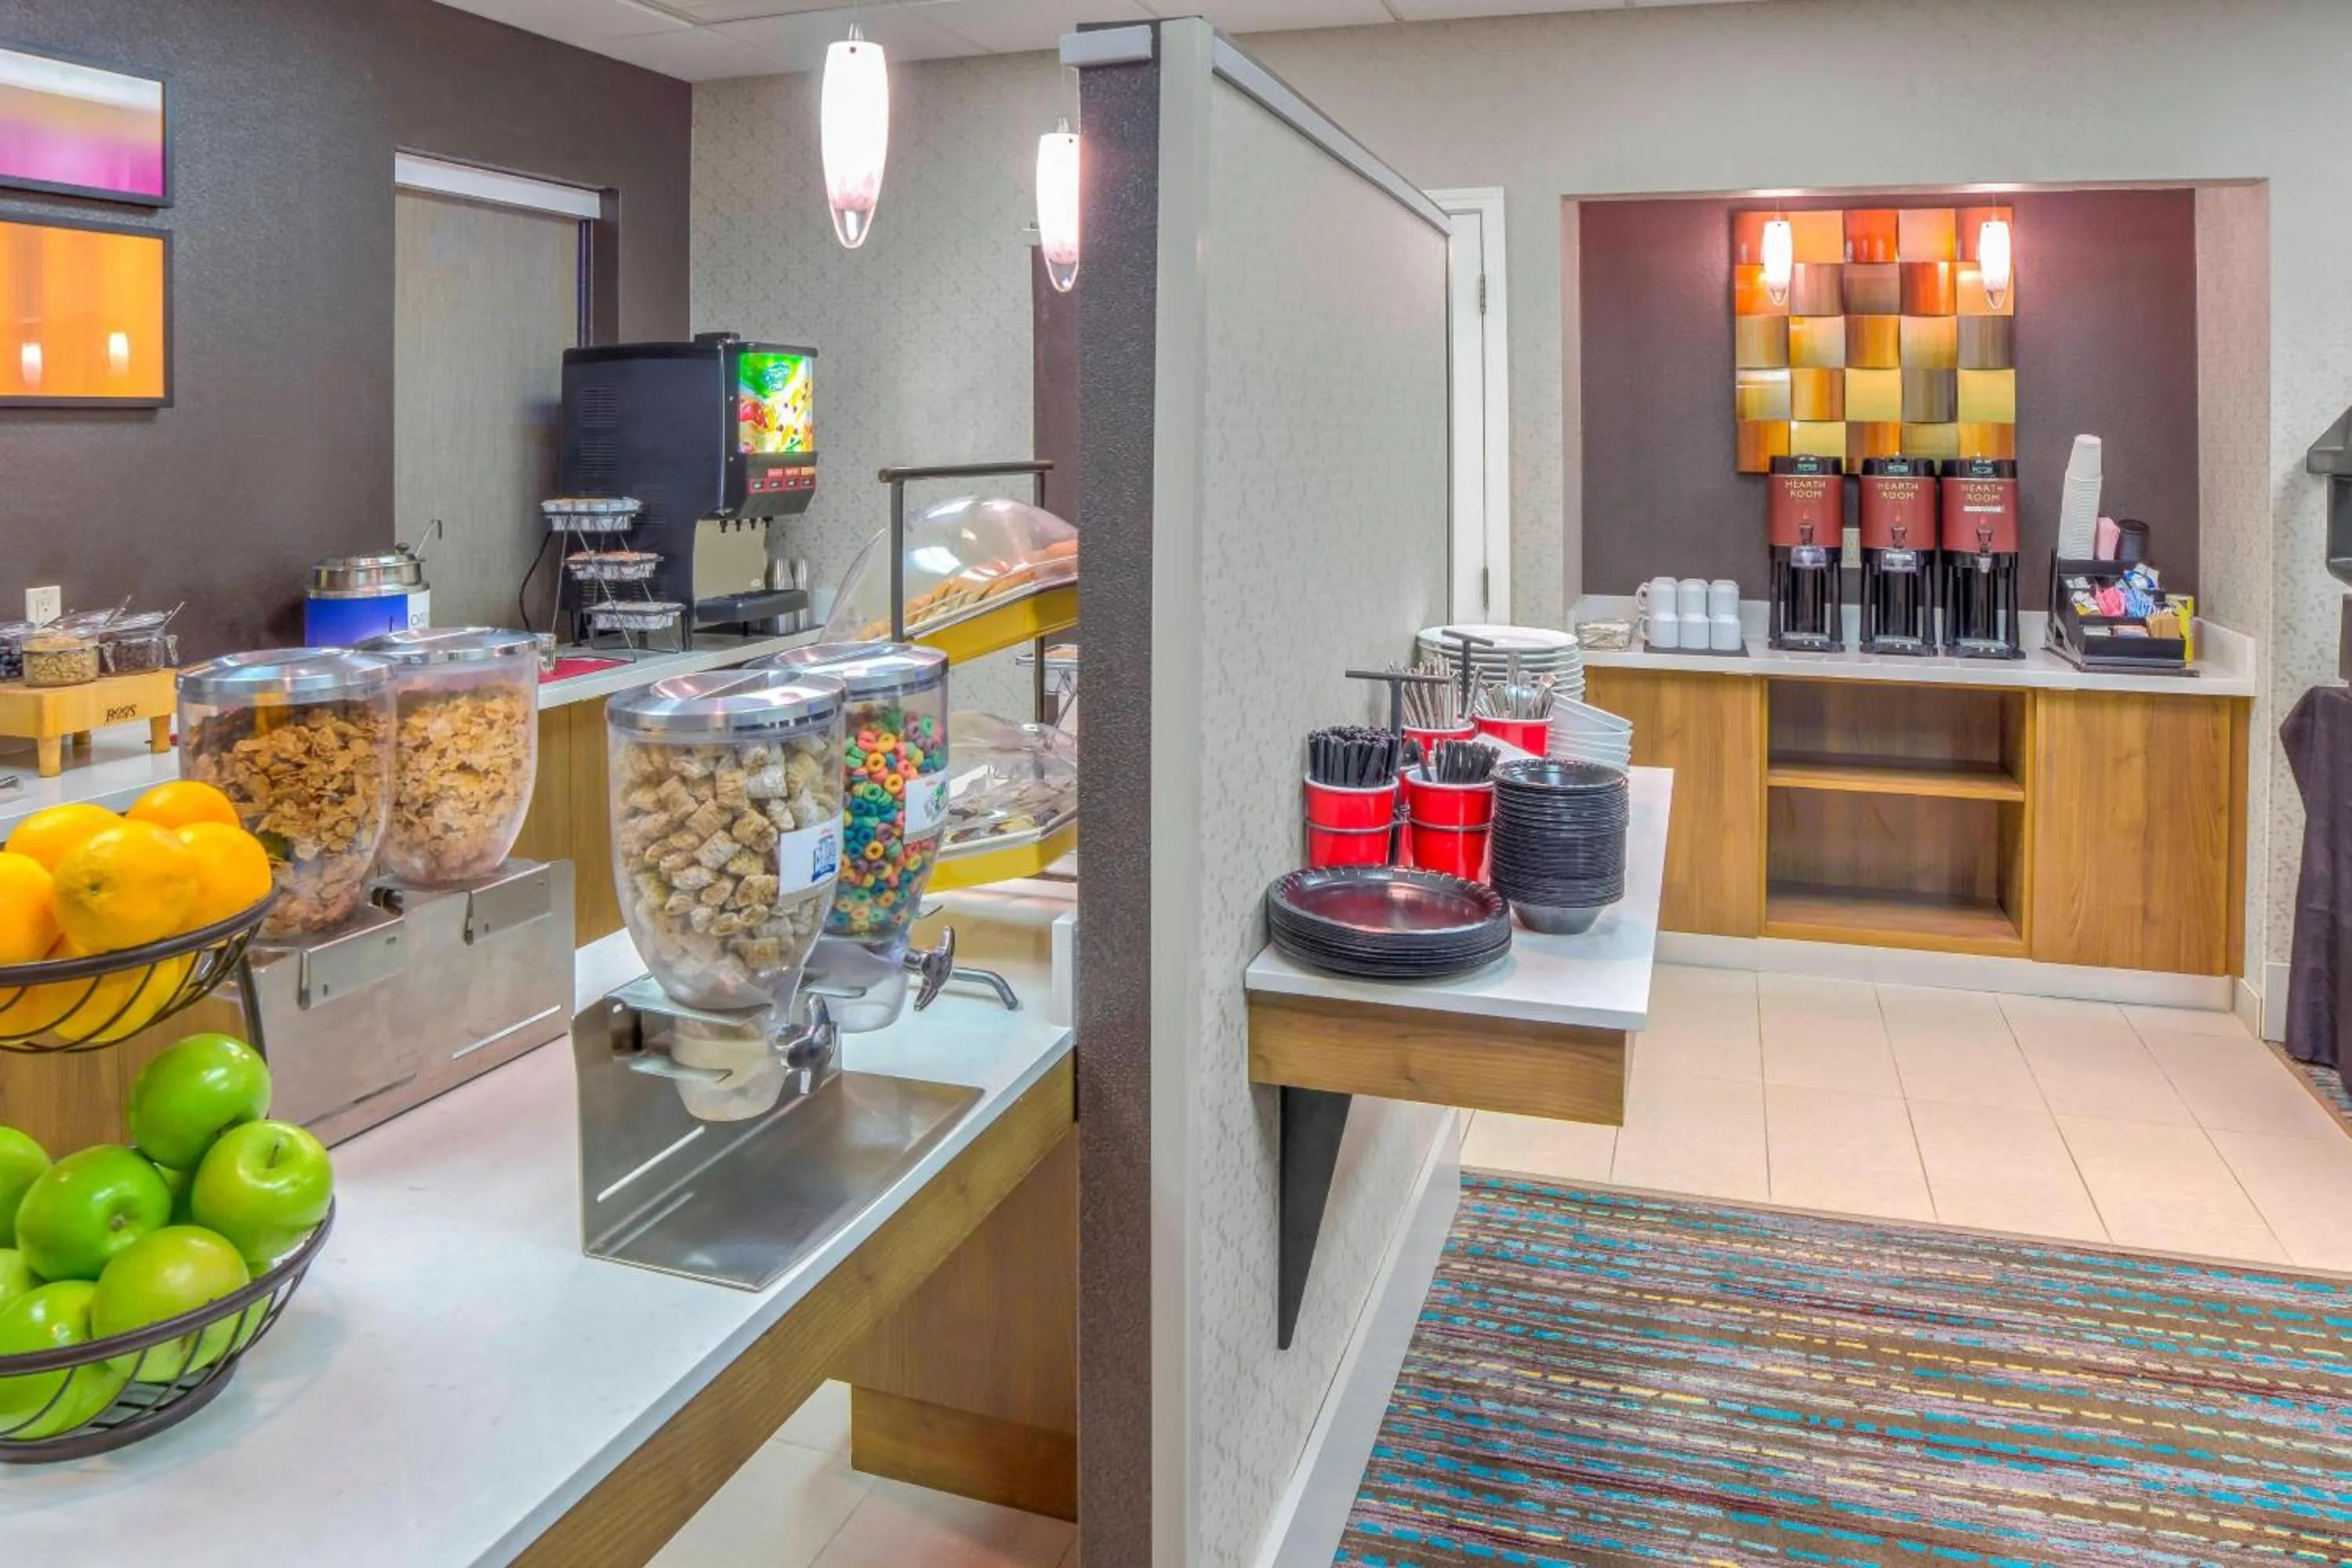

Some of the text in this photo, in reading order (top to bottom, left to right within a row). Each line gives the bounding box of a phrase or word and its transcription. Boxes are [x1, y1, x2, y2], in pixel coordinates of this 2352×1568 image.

[1784, 480, 1827, 489] HEARTH
[1878, 482, 1918, 491] HEARTH
[1961, 484, 2004, 492] HEARTH
[1790, 490, 1824, 499] ROOM
[1882, 491, 1915, 500] ROOM
